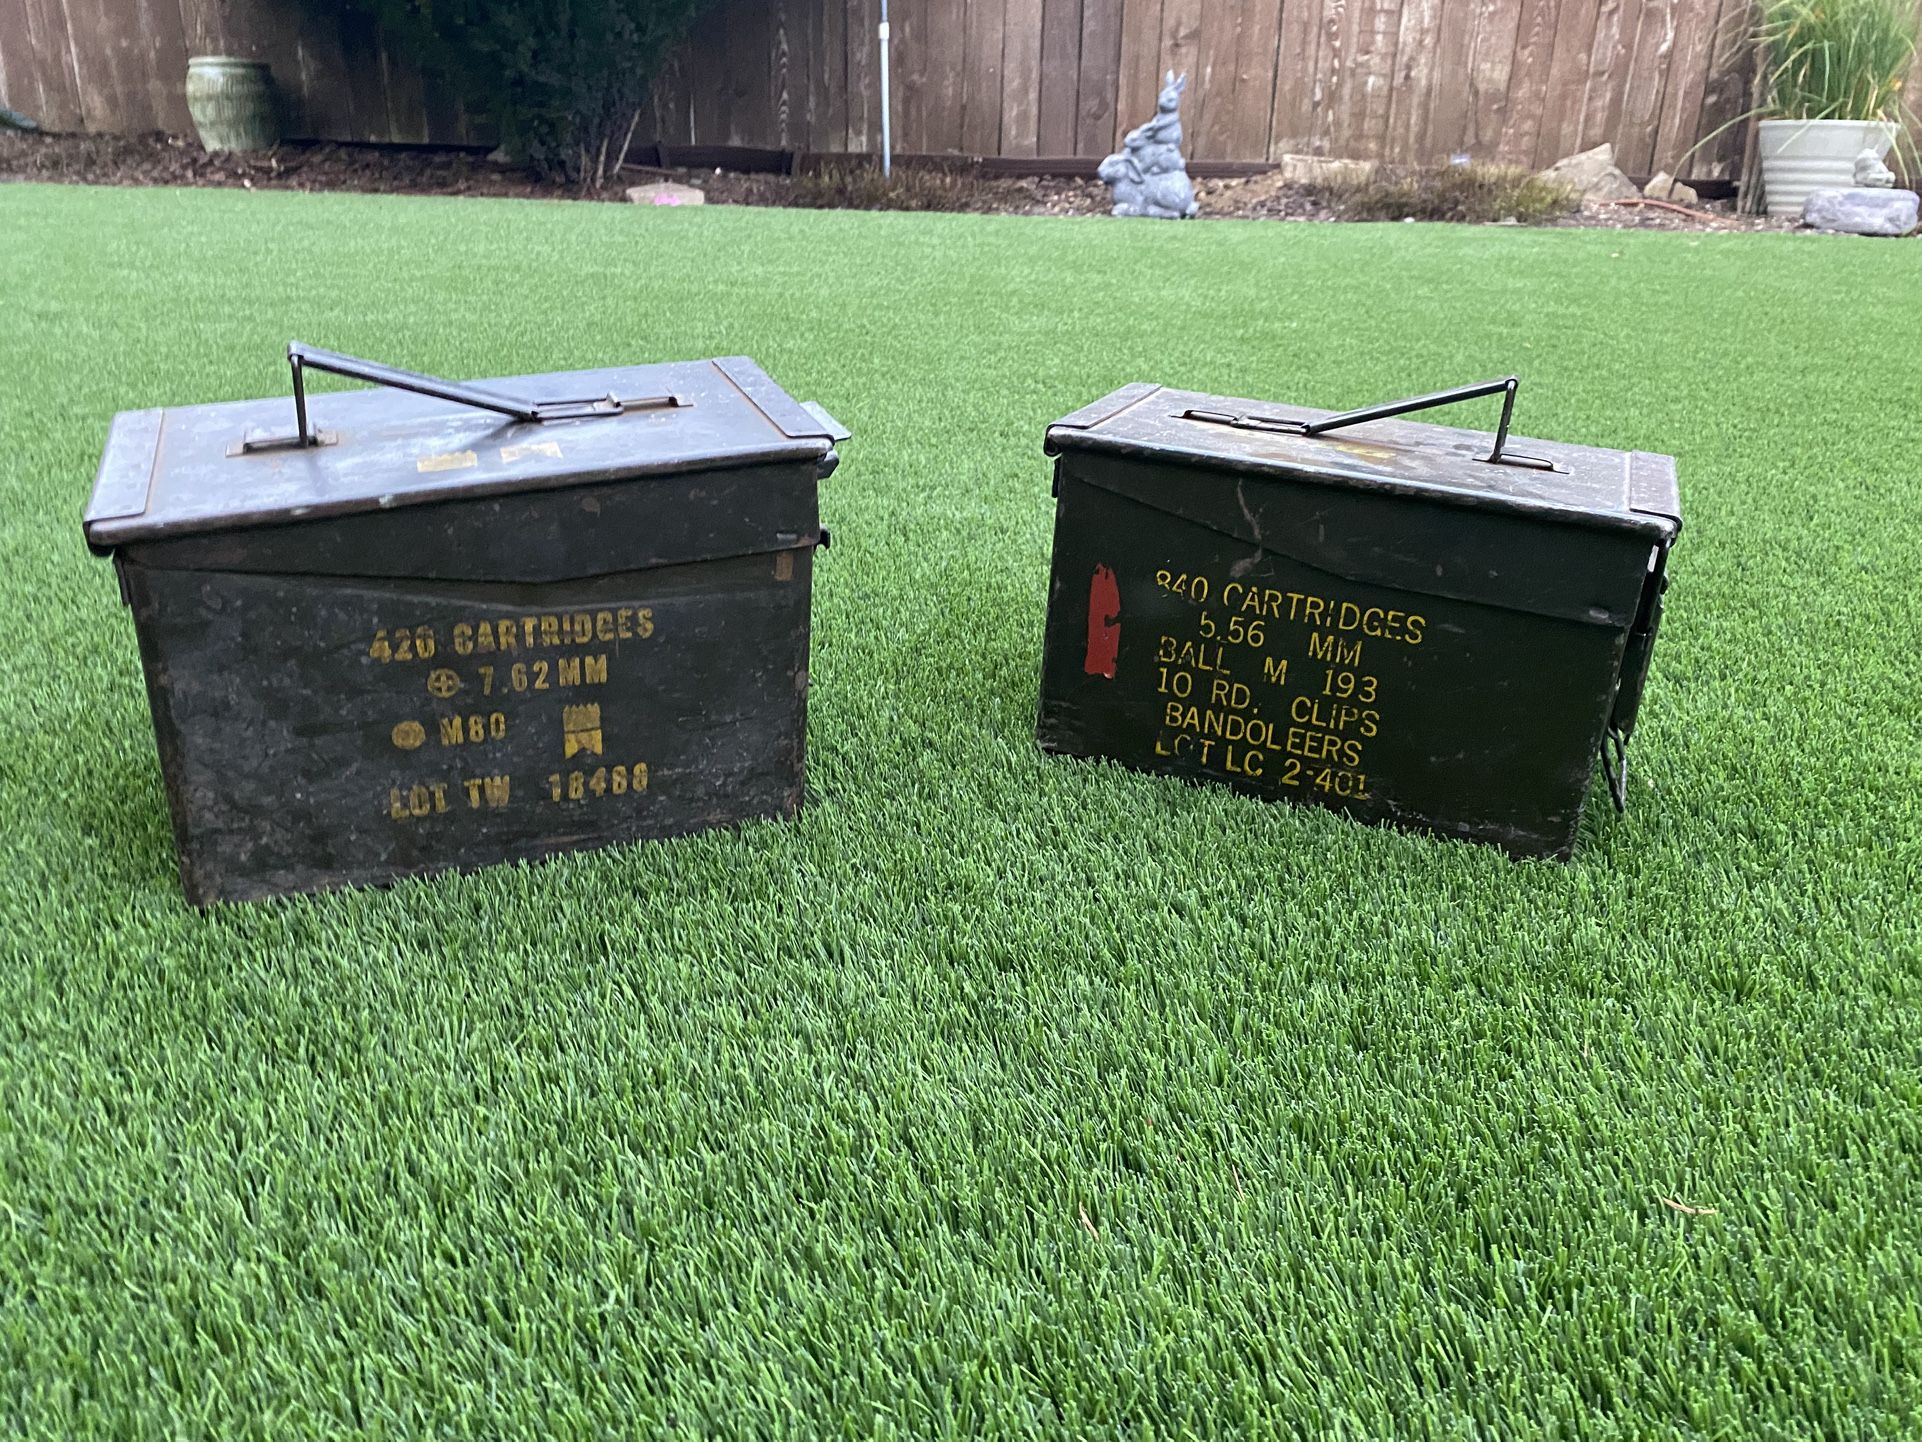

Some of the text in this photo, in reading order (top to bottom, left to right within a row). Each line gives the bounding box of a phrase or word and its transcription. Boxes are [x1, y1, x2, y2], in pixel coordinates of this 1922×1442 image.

[369, 607, 654, 664] 420 CARTRIDGES
[1199, 610, 1363, 667] 5.56 MM
[1223, 582, 1426, 645] CARTRIDGES
[1158, 635, 1378, 703] BALL M 193
[440, 711, 506, 746] M80
[1157, 667, 1380, 737] 10 RD. CLIPS
[1165, 701, 1363, 767] BANDOLEERS
[1225, 744, 1264, 777] LC
[389, 782, 447, 820] LOT
[464, 774, 510, 809] TW
